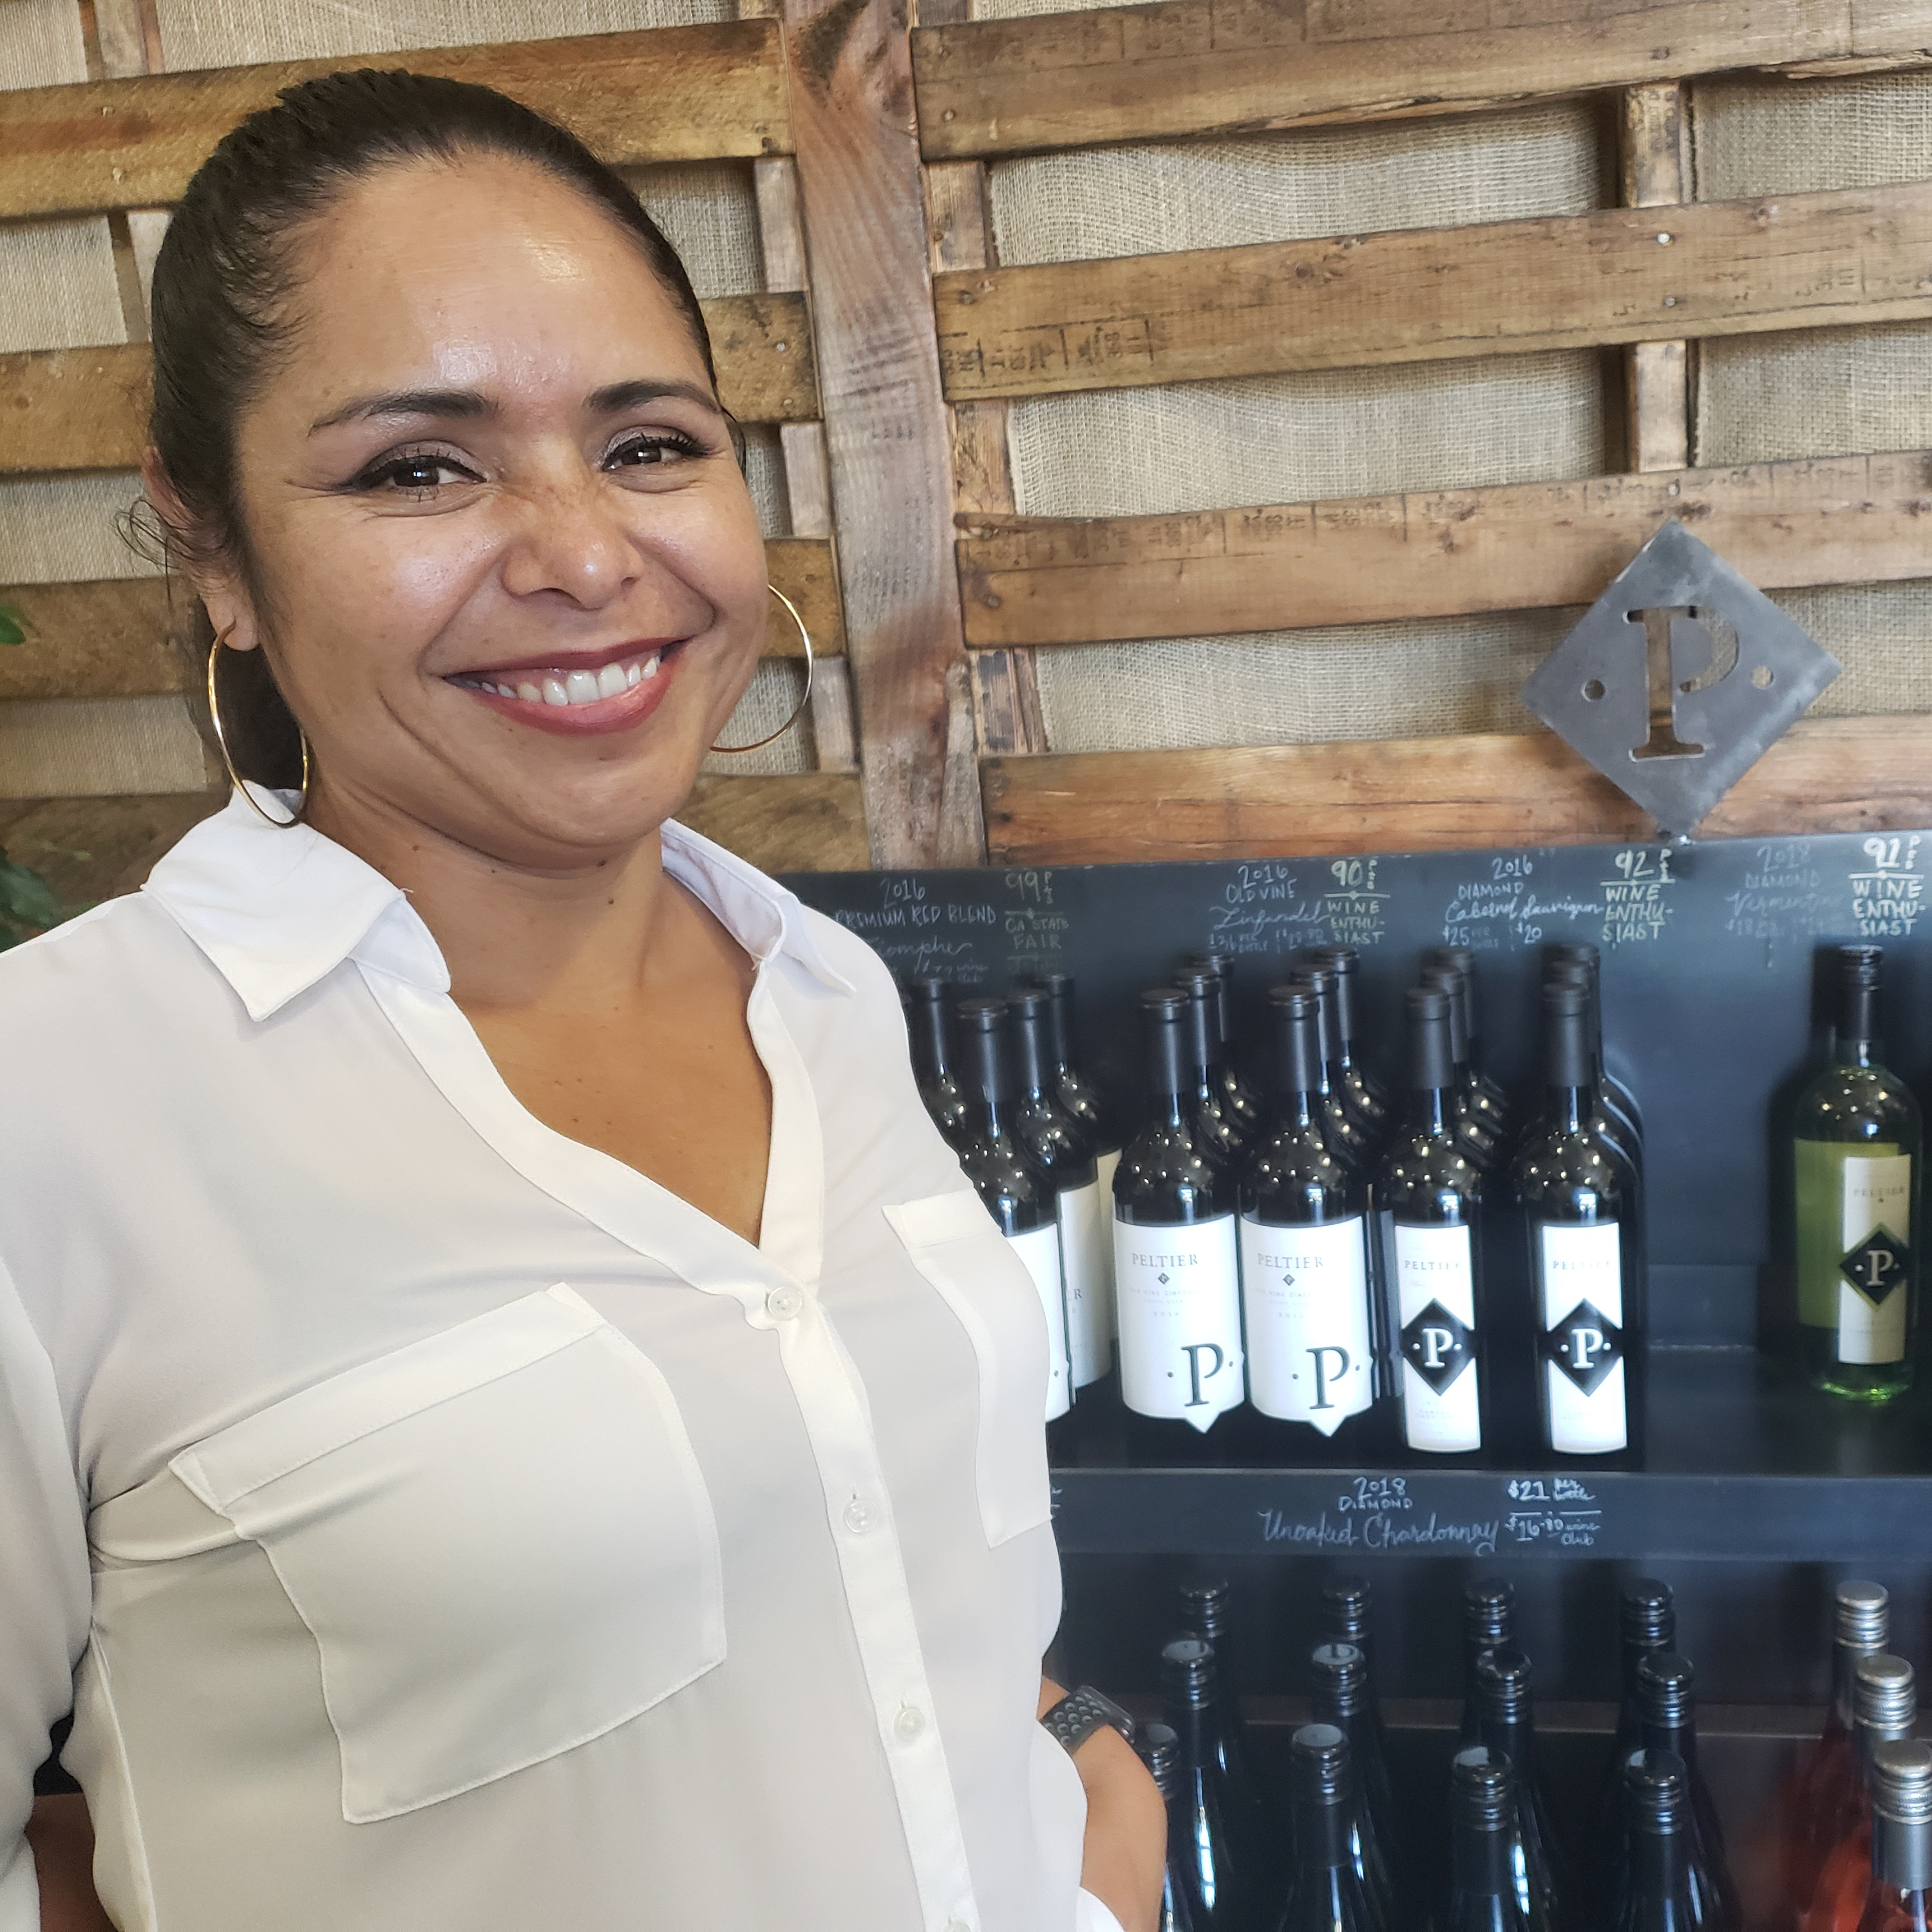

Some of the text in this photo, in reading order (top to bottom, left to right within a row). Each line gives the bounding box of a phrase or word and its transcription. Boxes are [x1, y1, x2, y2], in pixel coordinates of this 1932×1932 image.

[1623, 605, 1739, 762] P
[1615, 849, 1654, 878] 92
[1863, 837, 1900, 868] 91
[1238, 864, 1289, 889] 2016
[1331, 860, 1363, 887] 90
[1492, 855, 1533, 880] 2016
[880, 878, 925, 909] 2016
[1005, 871, 1041, 902] 99
[1226, 878, 1298, 904] OLD VINE
[1458, 882, 1524, 900] DIAMOND
[1605, 884, 1661, 902] WINE
[1852, 880, 1923, 899] WINE
[835, 904, 997, 929] PREMIUM RED BLEND
[1327, 901, 1379, 914] WINE
[1005, 918, 1025, 934] CA
[1602, 922, 1666, 942] SIAST
[1861, 918, 1917, 936] SIAST
[1013, 933, 1062, 949] FAIR
[1132, 1253, 1198, 1267] PELTIER
[1257, 1253, 1324, 1269] PELTIER
[1405, 1260, 1461, 1271] PELTIER
[1866, 1249, 1895, 1287] P
[1421, 1327, 1454, 1368] P
[1571, 1328, 1604, 1369] P
[1180, 1343, 1224, 1407] P
[1305, 1346, 1350, 1410] P
[1354, 1477, 1406, 1499] 2018
[1507, 1479, 1551, 1502] $21
[1338, 1497, 1414, 1512] DIAMOND
